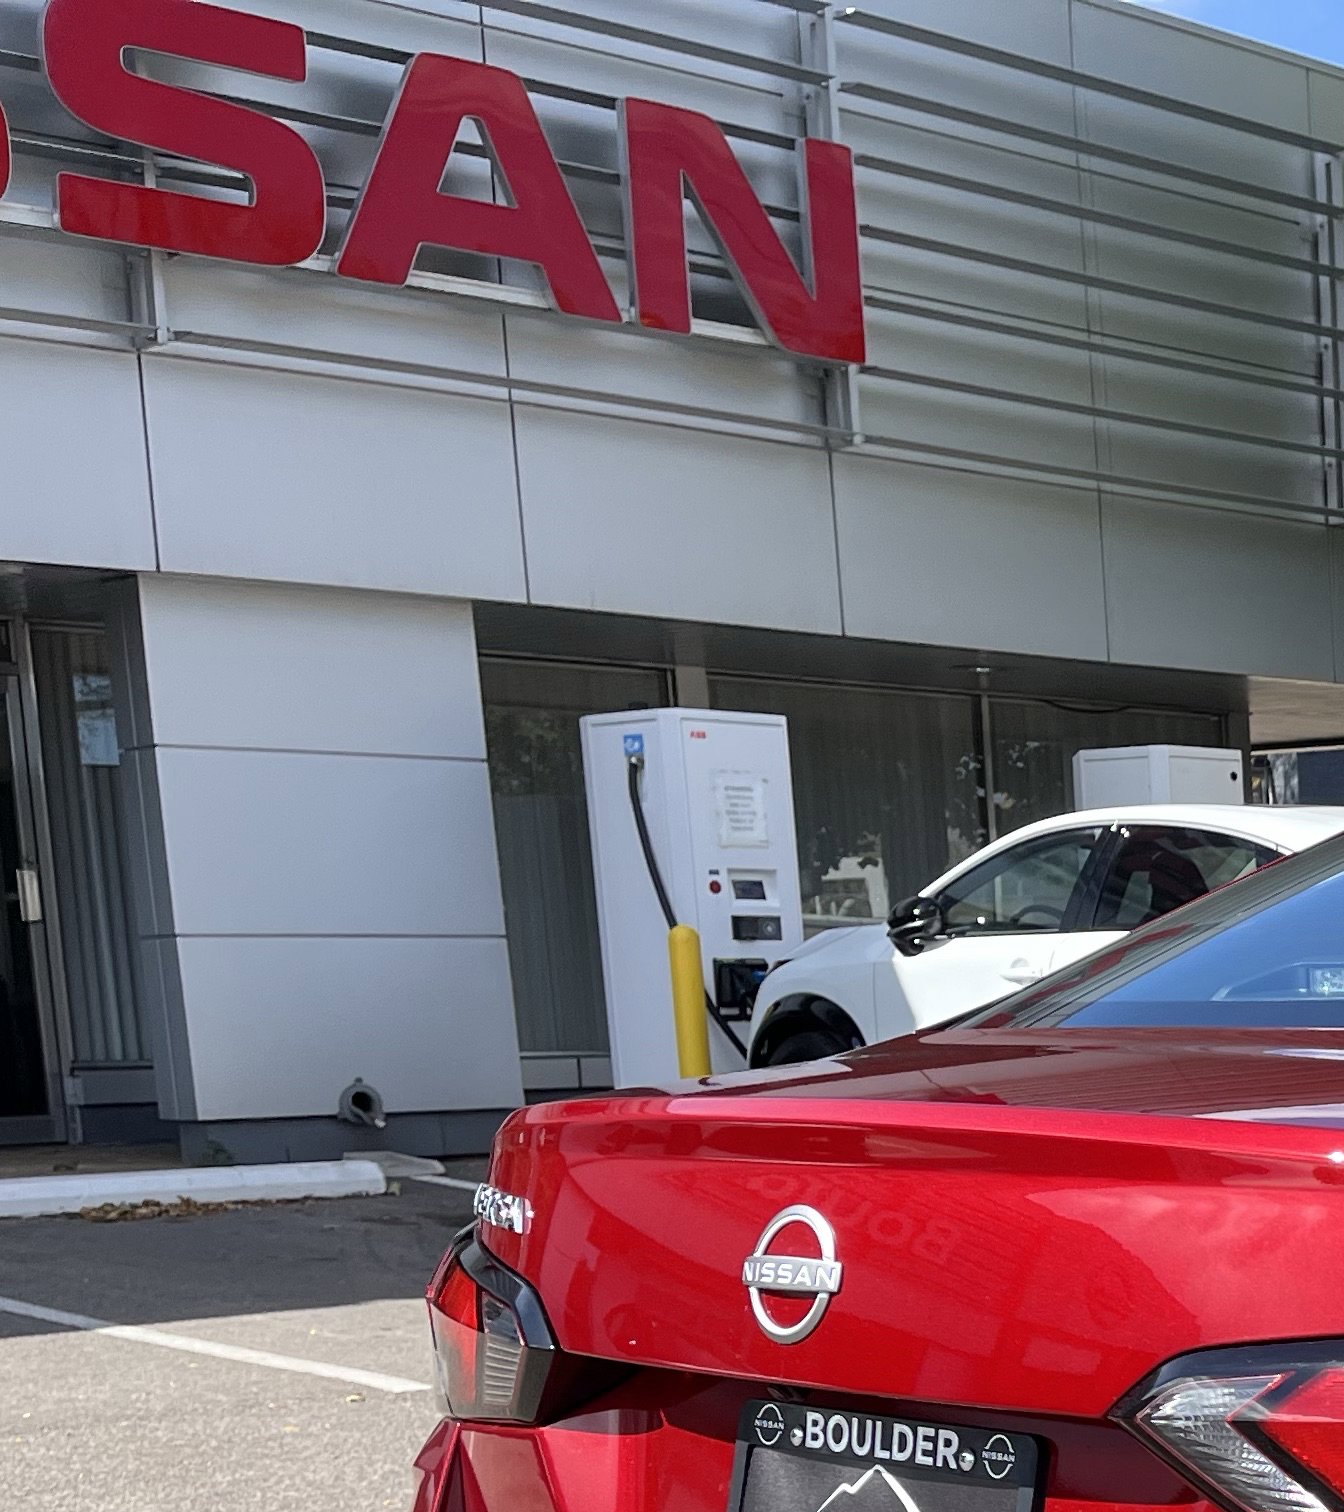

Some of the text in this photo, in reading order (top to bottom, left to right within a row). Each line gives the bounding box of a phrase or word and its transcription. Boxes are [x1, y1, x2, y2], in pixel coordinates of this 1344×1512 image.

[0, 0, 866, 364] SAN
[743, 1258, 838, 1290] NISSAN
[754, 1419, 784, 1430] NISSAN
[804, 1411, 960, 1470] BOULDER
[982, 1451, 1015, 1462] NISSAN
